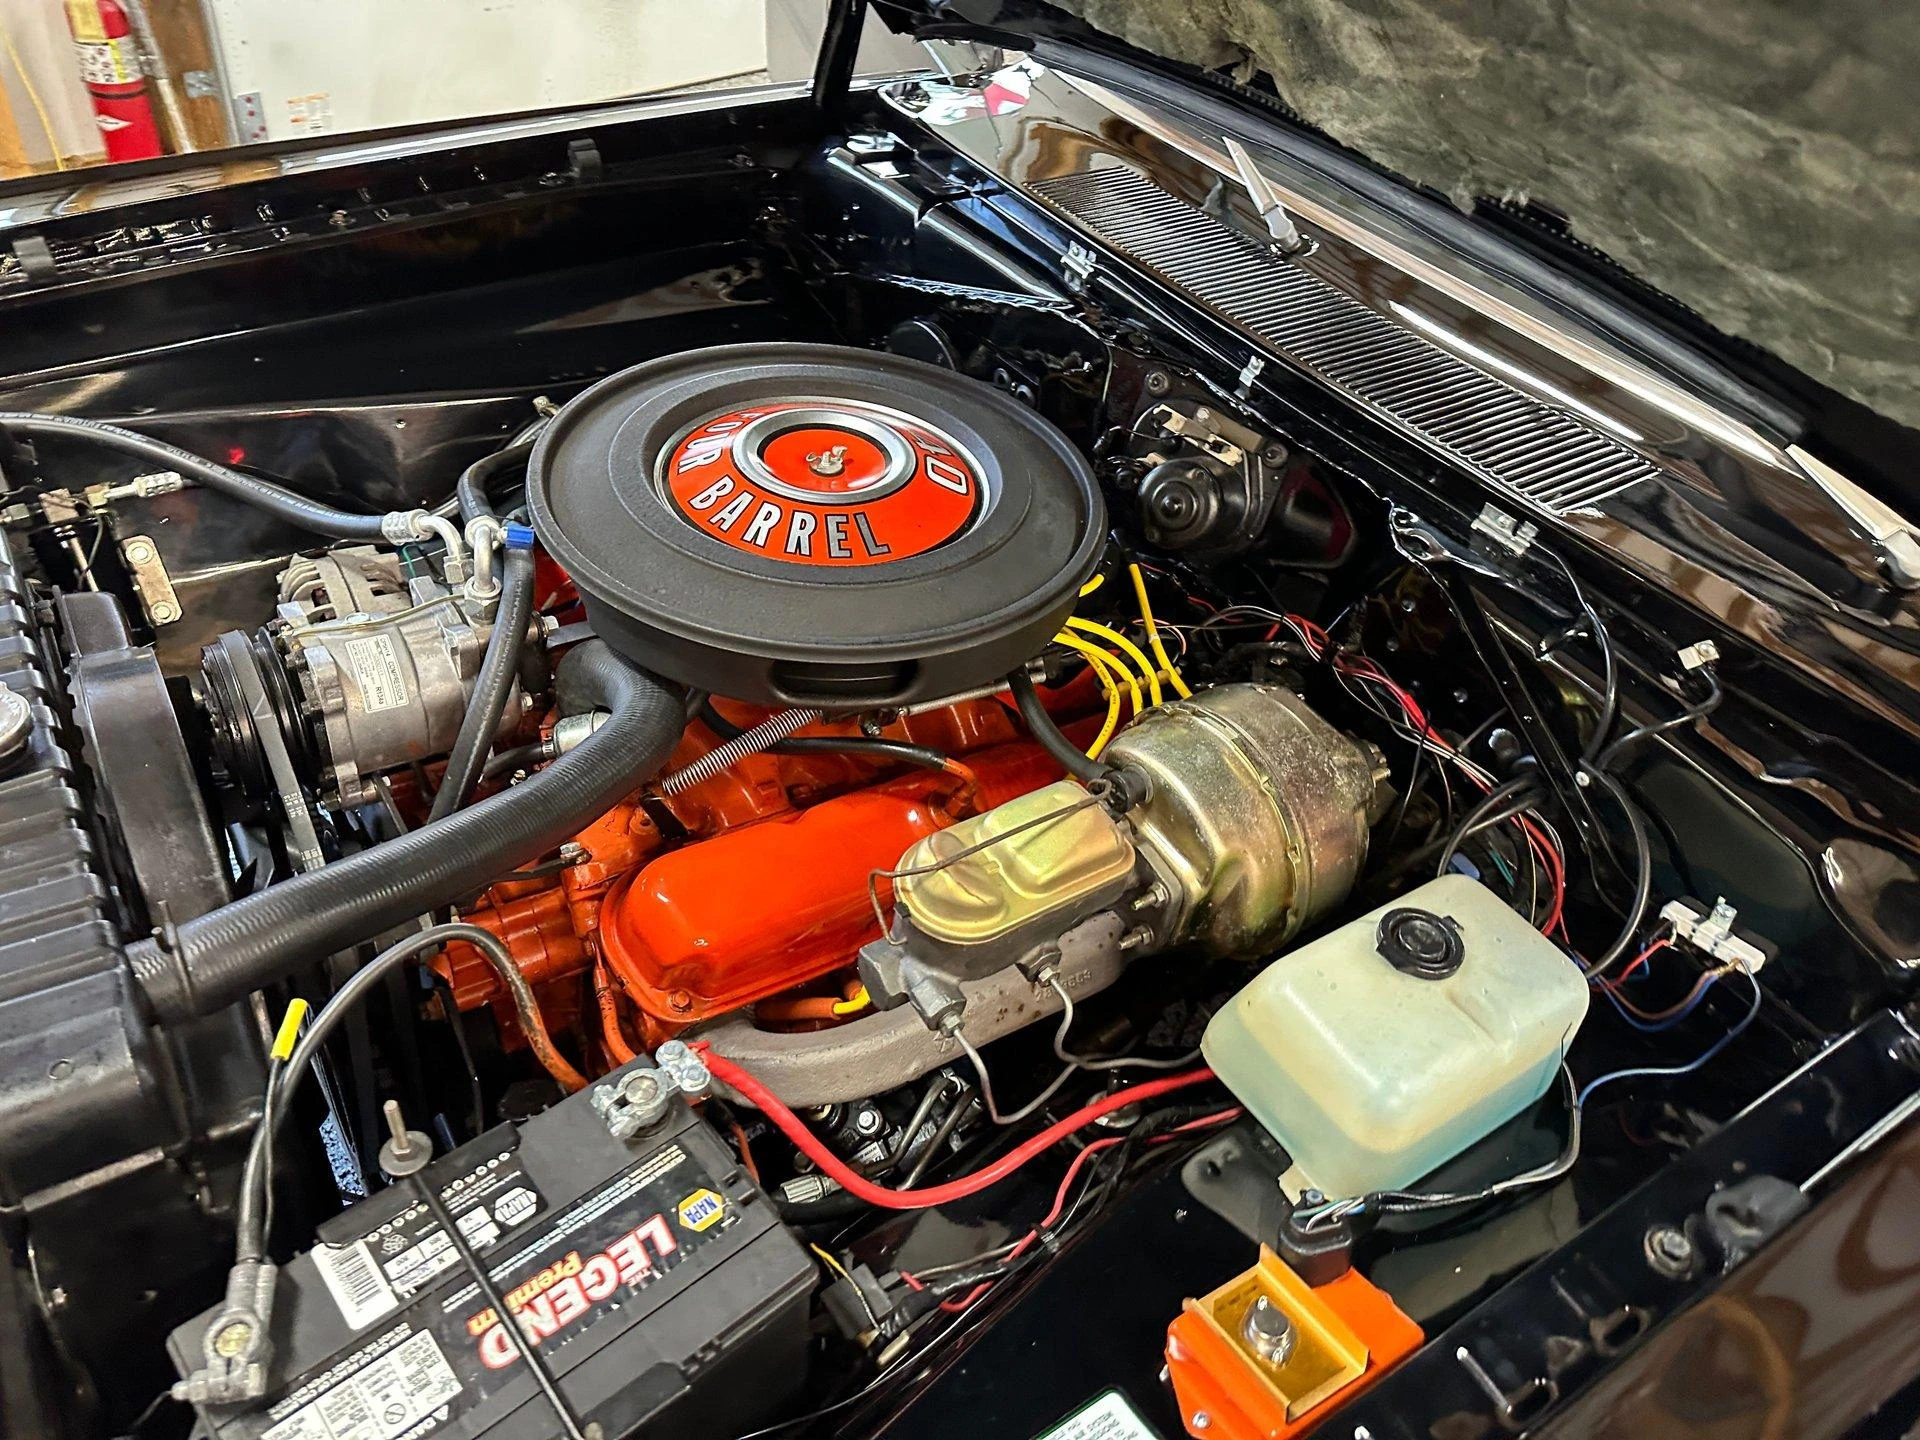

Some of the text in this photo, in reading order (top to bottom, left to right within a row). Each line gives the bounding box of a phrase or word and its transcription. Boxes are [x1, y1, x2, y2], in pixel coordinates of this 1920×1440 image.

[676, 412, 893, 558] FOUR BARREL
[387, 661, 404, 701] COMPRESSOR
[498, 1191, 533, 1220] NAPA
[682, 1194, 718, 1226] NAPA
[466, 1250, 583, 1336] Premim
[480, 1213, 677, 1370] LEGEND
[625, 1266, 652, 1287] THE
